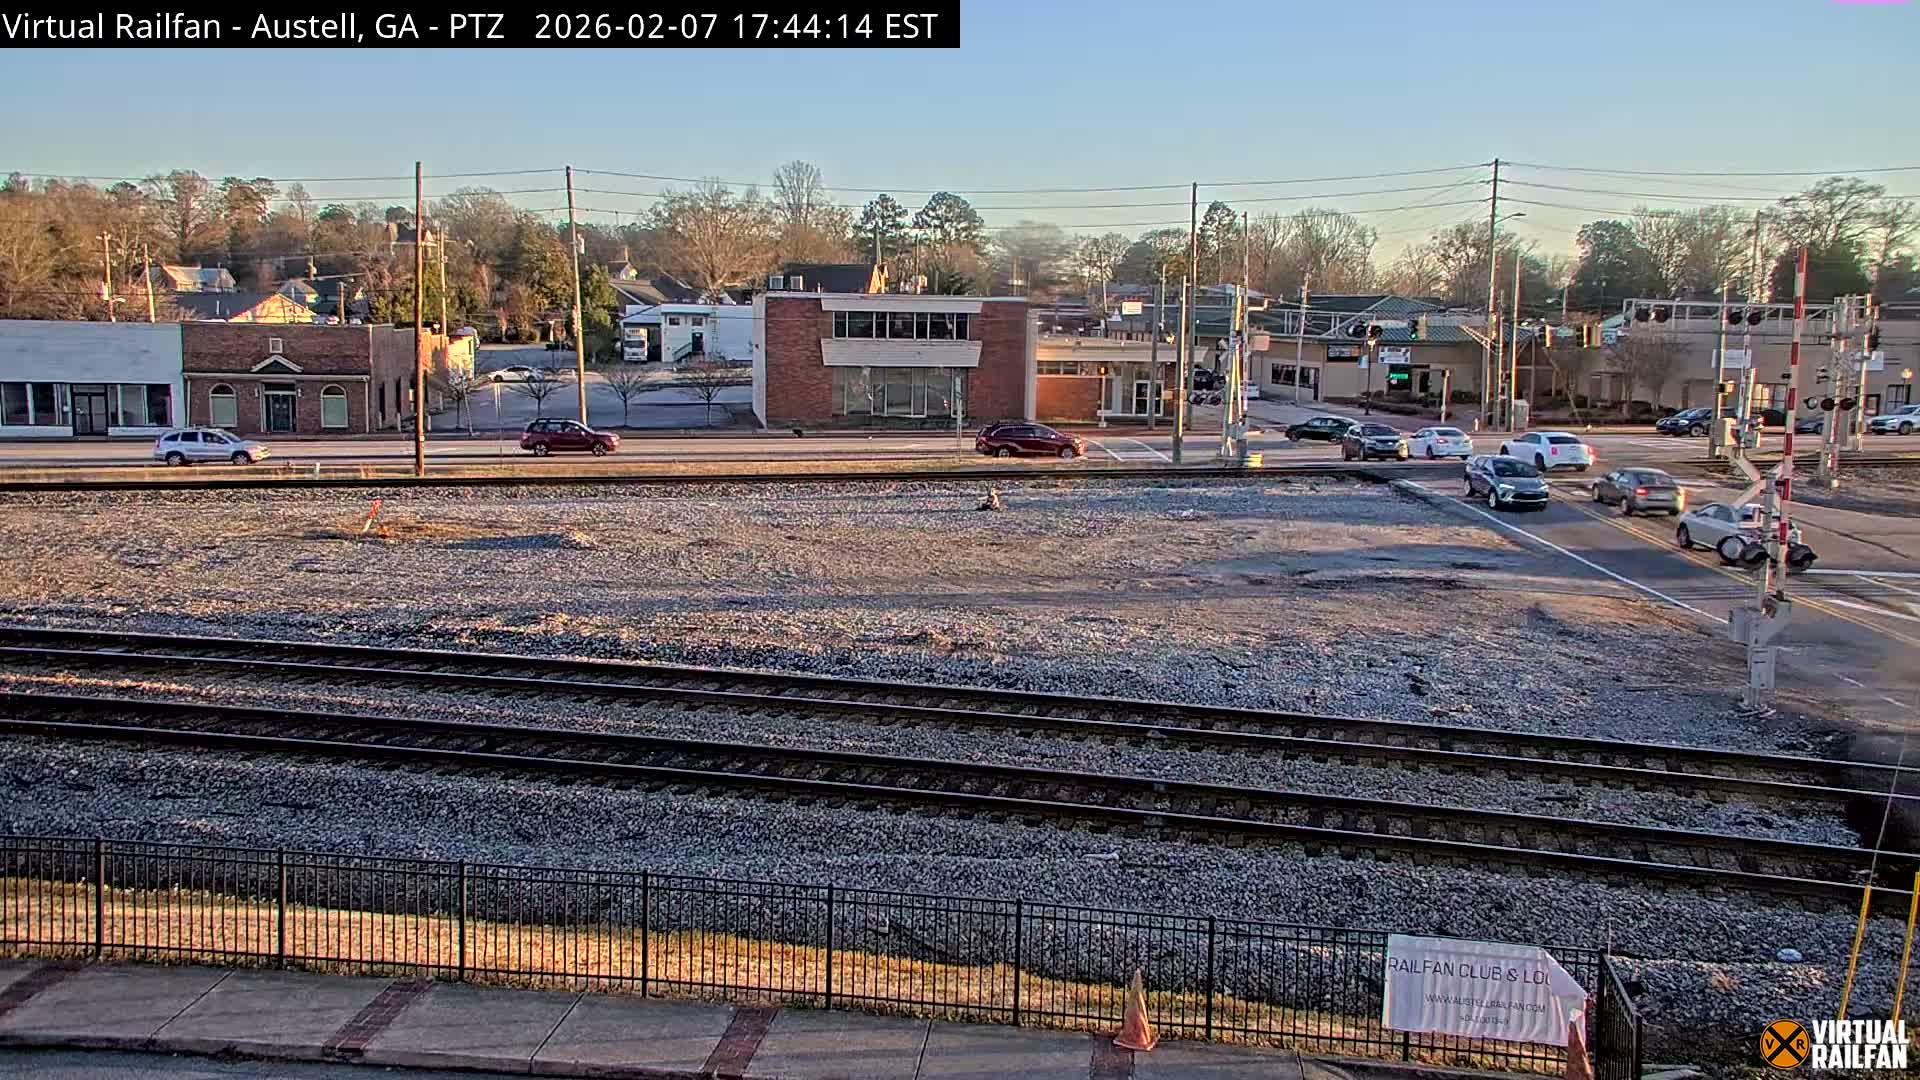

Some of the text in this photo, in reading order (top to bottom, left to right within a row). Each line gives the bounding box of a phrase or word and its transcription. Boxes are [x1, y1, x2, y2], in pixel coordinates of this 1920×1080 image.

[1388, 957, 1455, 977] RAILFAN
[1458, 963, 1503, 982] CLUB
[1506, 968, 1519, 982] &
